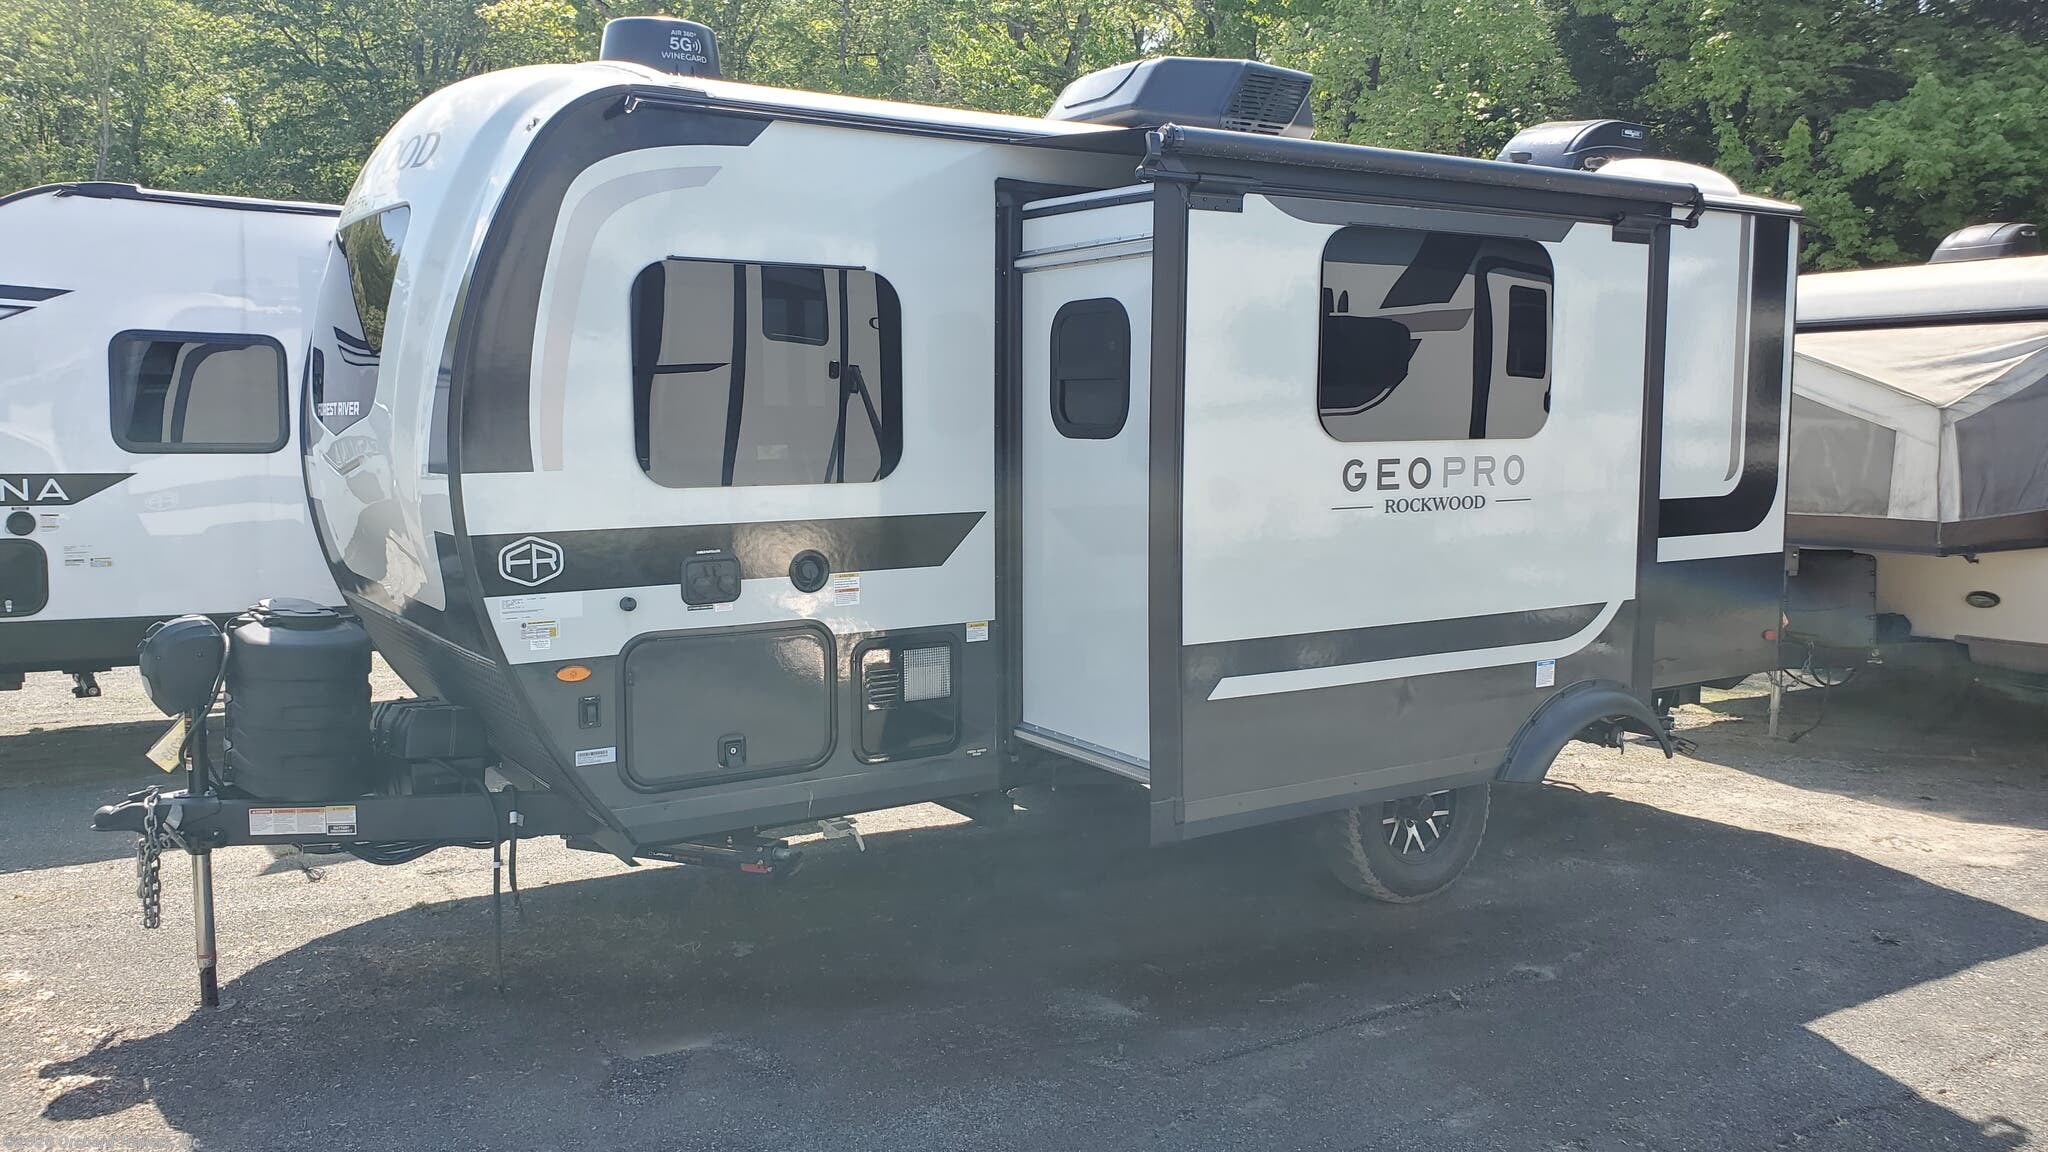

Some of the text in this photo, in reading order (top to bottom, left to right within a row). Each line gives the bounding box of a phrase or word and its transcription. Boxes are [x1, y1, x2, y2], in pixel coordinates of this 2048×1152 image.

[669, 37, 692, 51] 5G
[661, 51, 707, 63] WINEGARD
[317, 401, 360, 416] FOREST RIVER
[1384, 494, 1486, 513] ROCKWOOD
[505, 543, 557, 580] FR
